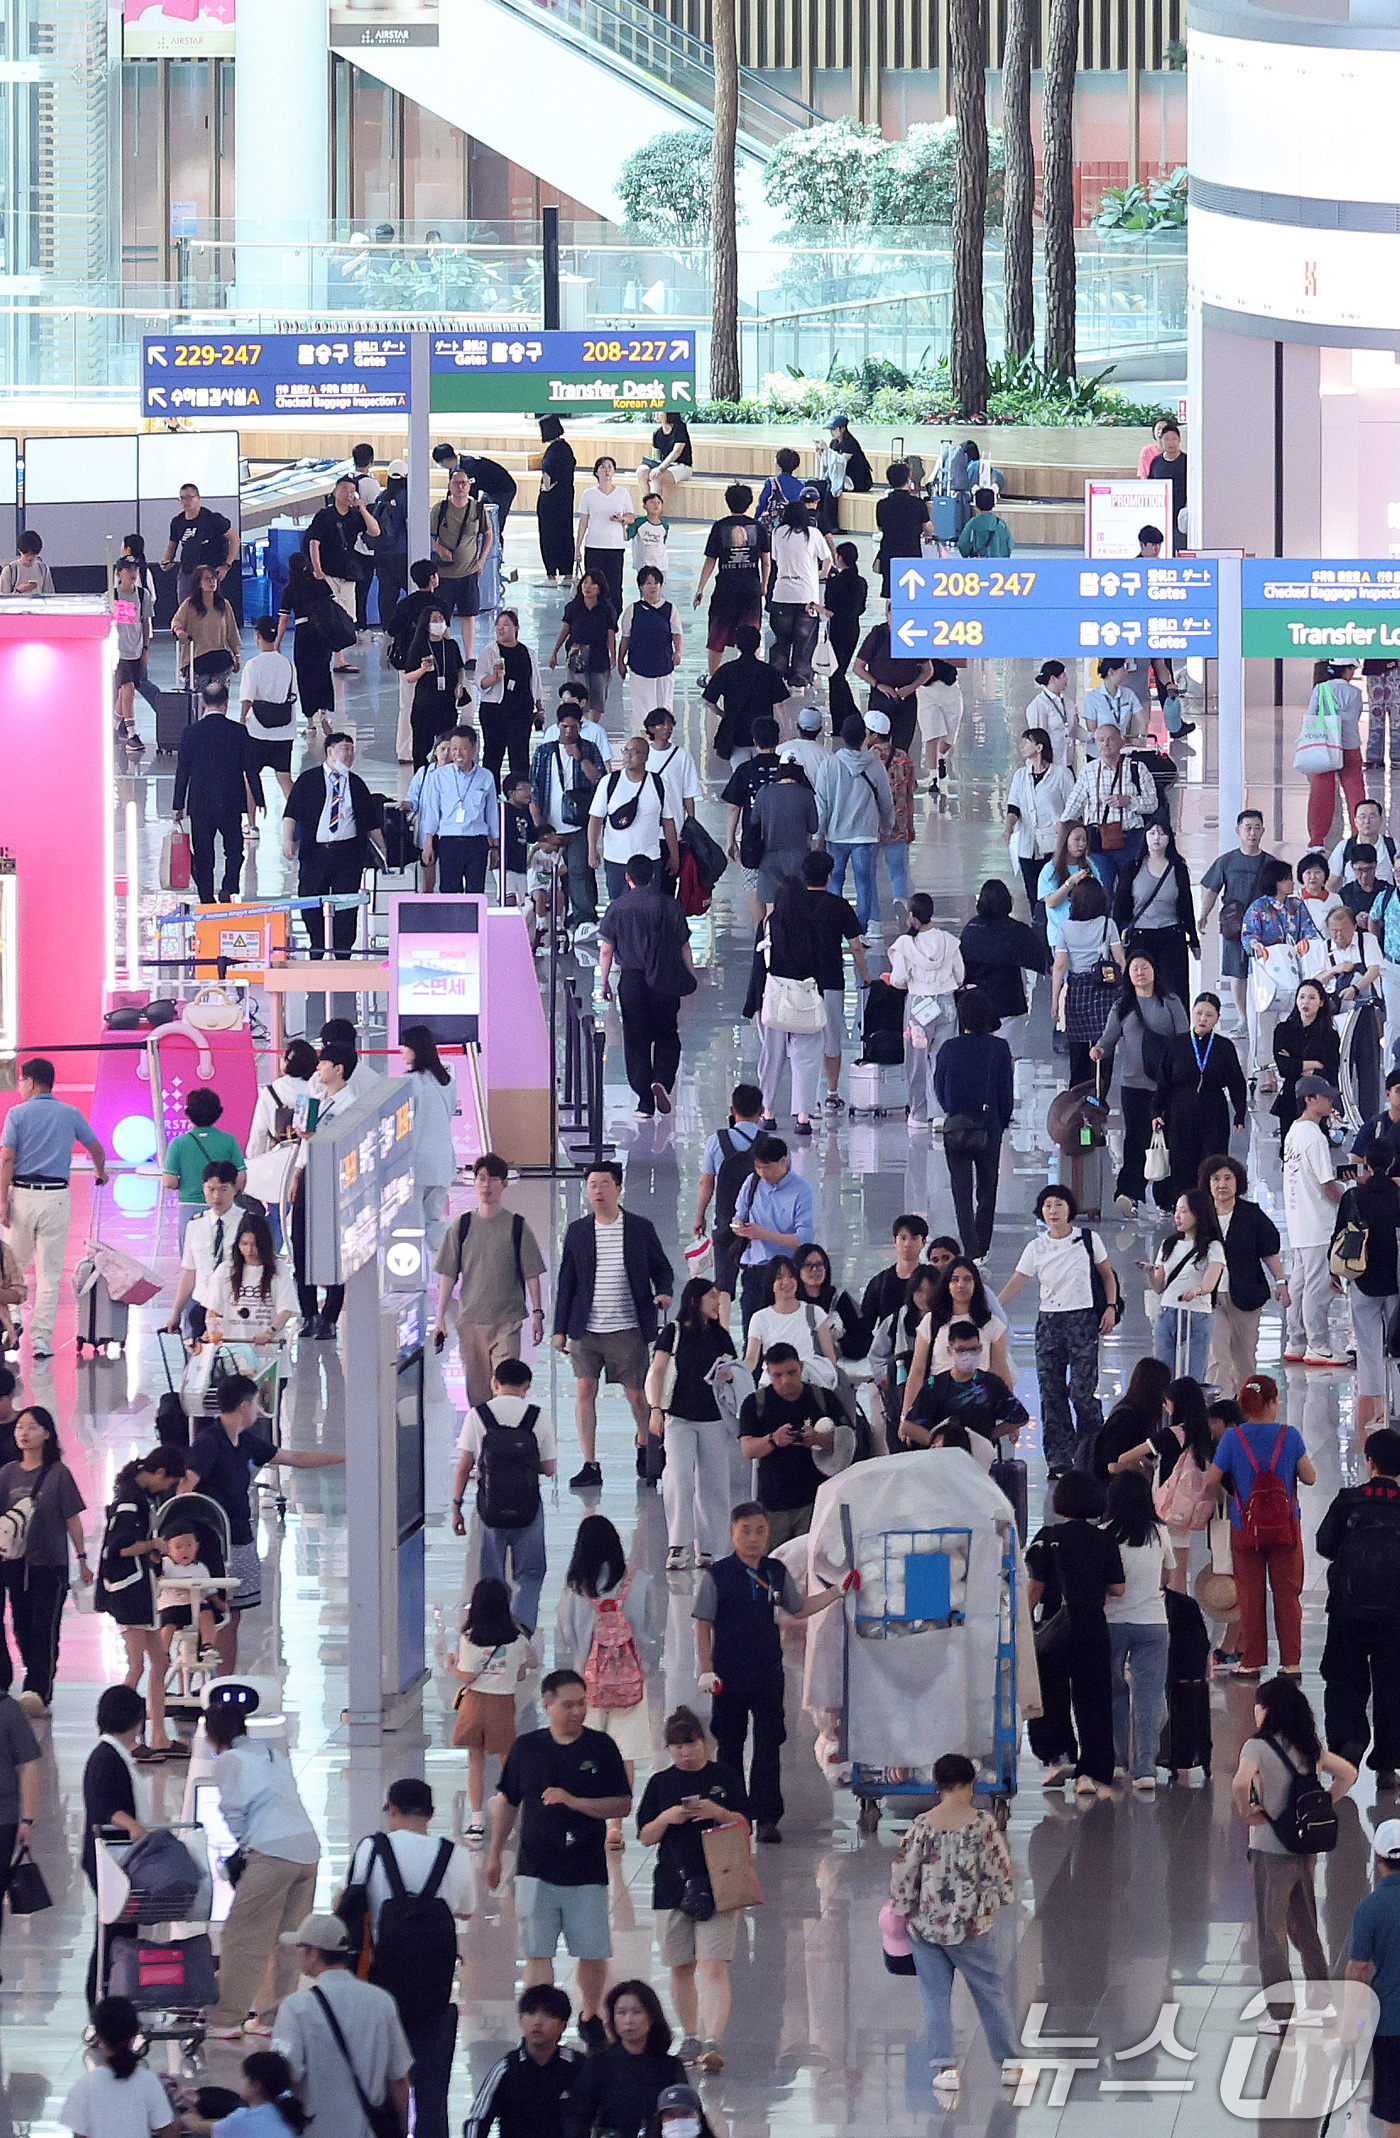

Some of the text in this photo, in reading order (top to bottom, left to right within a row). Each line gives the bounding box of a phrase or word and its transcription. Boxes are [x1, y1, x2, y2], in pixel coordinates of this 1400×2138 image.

[171, 37, 204, 45] AIRSTAR
[374, 29, 409, 40] AIRSTAR
[175, 345, 262, 366] 229-247
[582, 341, 667, 362] 208-227
[353, 354, 387, 367] Gates
[455, 354, 487, 366] Gates
[549, 379, 665, 398] Transfer Desk
[275, 396, 405, 410] Checked Baggage Inspection A
[613, 399, 665, 408] Korean Air
[1111, 494, 1163, 508] PROMOTION
[932, 572, 1037, 597] 208-247
[1147, 586, 1187, 600] Gates
[1263, 586, 1309, 599] Checked
[1311, 586, 1357, 602] Baggage
[932, 621, 983, 646] 248
[1287, 621, 1377, 646] Transfer
[1147, 635, 1187, 650] Gates
